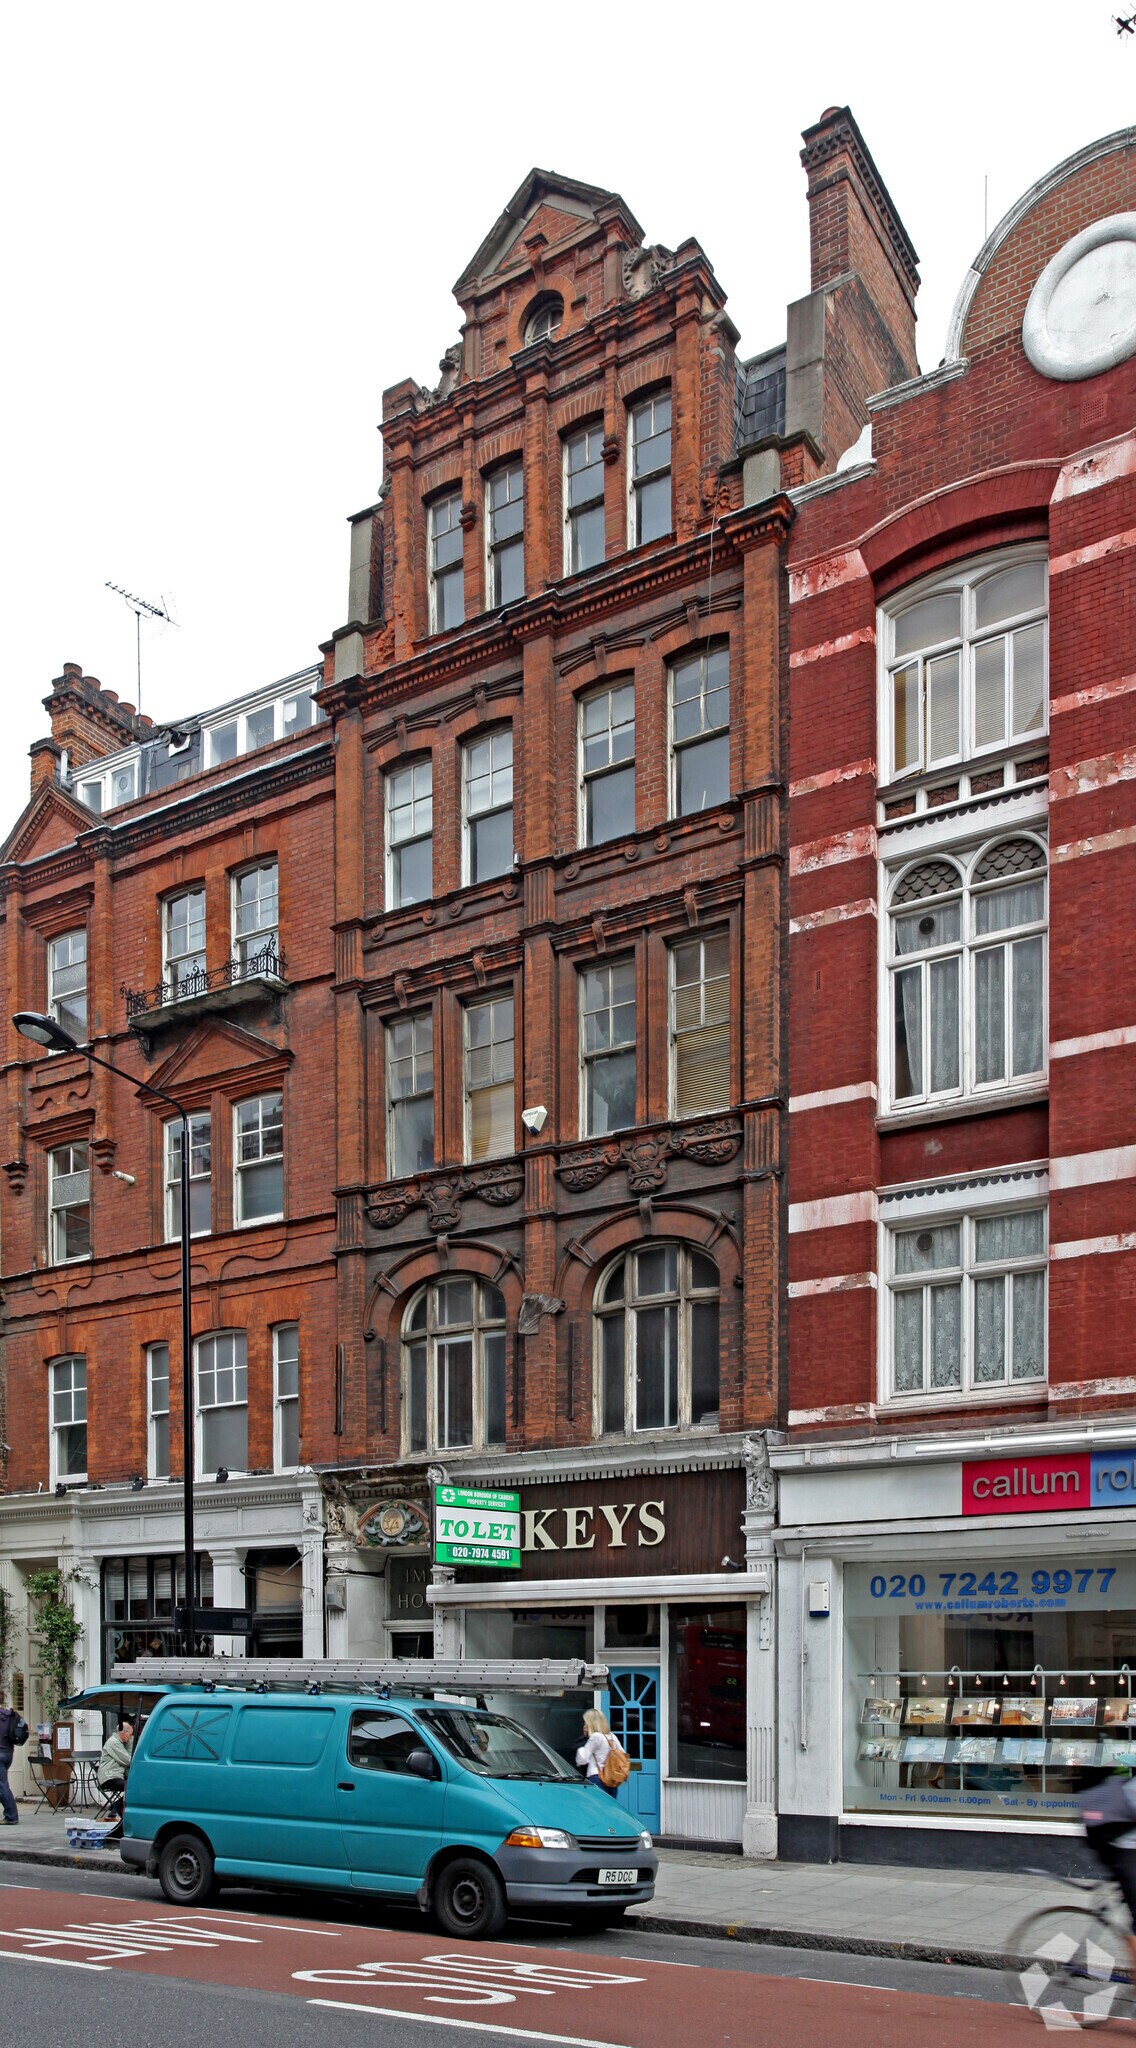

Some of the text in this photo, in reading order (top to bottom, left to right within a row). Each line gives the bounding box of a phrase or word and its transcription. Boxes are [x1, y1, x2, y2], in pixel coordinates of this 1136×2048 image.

[972, 1459, 1136, 1499] callum ro
[474, 1491, 491, 1499] BOROUGH
[488, 1500, 506, 1508] SERVICES
[440, 1519, 516, 1541] TO LET
[521, 1500, 666, 1551] KEYS
[452, 1546, 510, 1560] 020-7974 4591
[406, 1569, 433, 1583] IM
[870, 1568, 1117, 1598] 020 7242 9977
[915, 1597, 1067, 1610] www.callumroberts.com
[880, 1793, 897, 1801] Mon
[905, 1793, 916, 1802] Fri
[920, 1794, 951, 1803] 9.00am
[1003, 1798, 1018, 1806] Sat
[1026, 1799, 1038, 1808] By
[605, 1871, 633, 1882] R5 DCC
[291, 1953, 648, 2005] BUS
